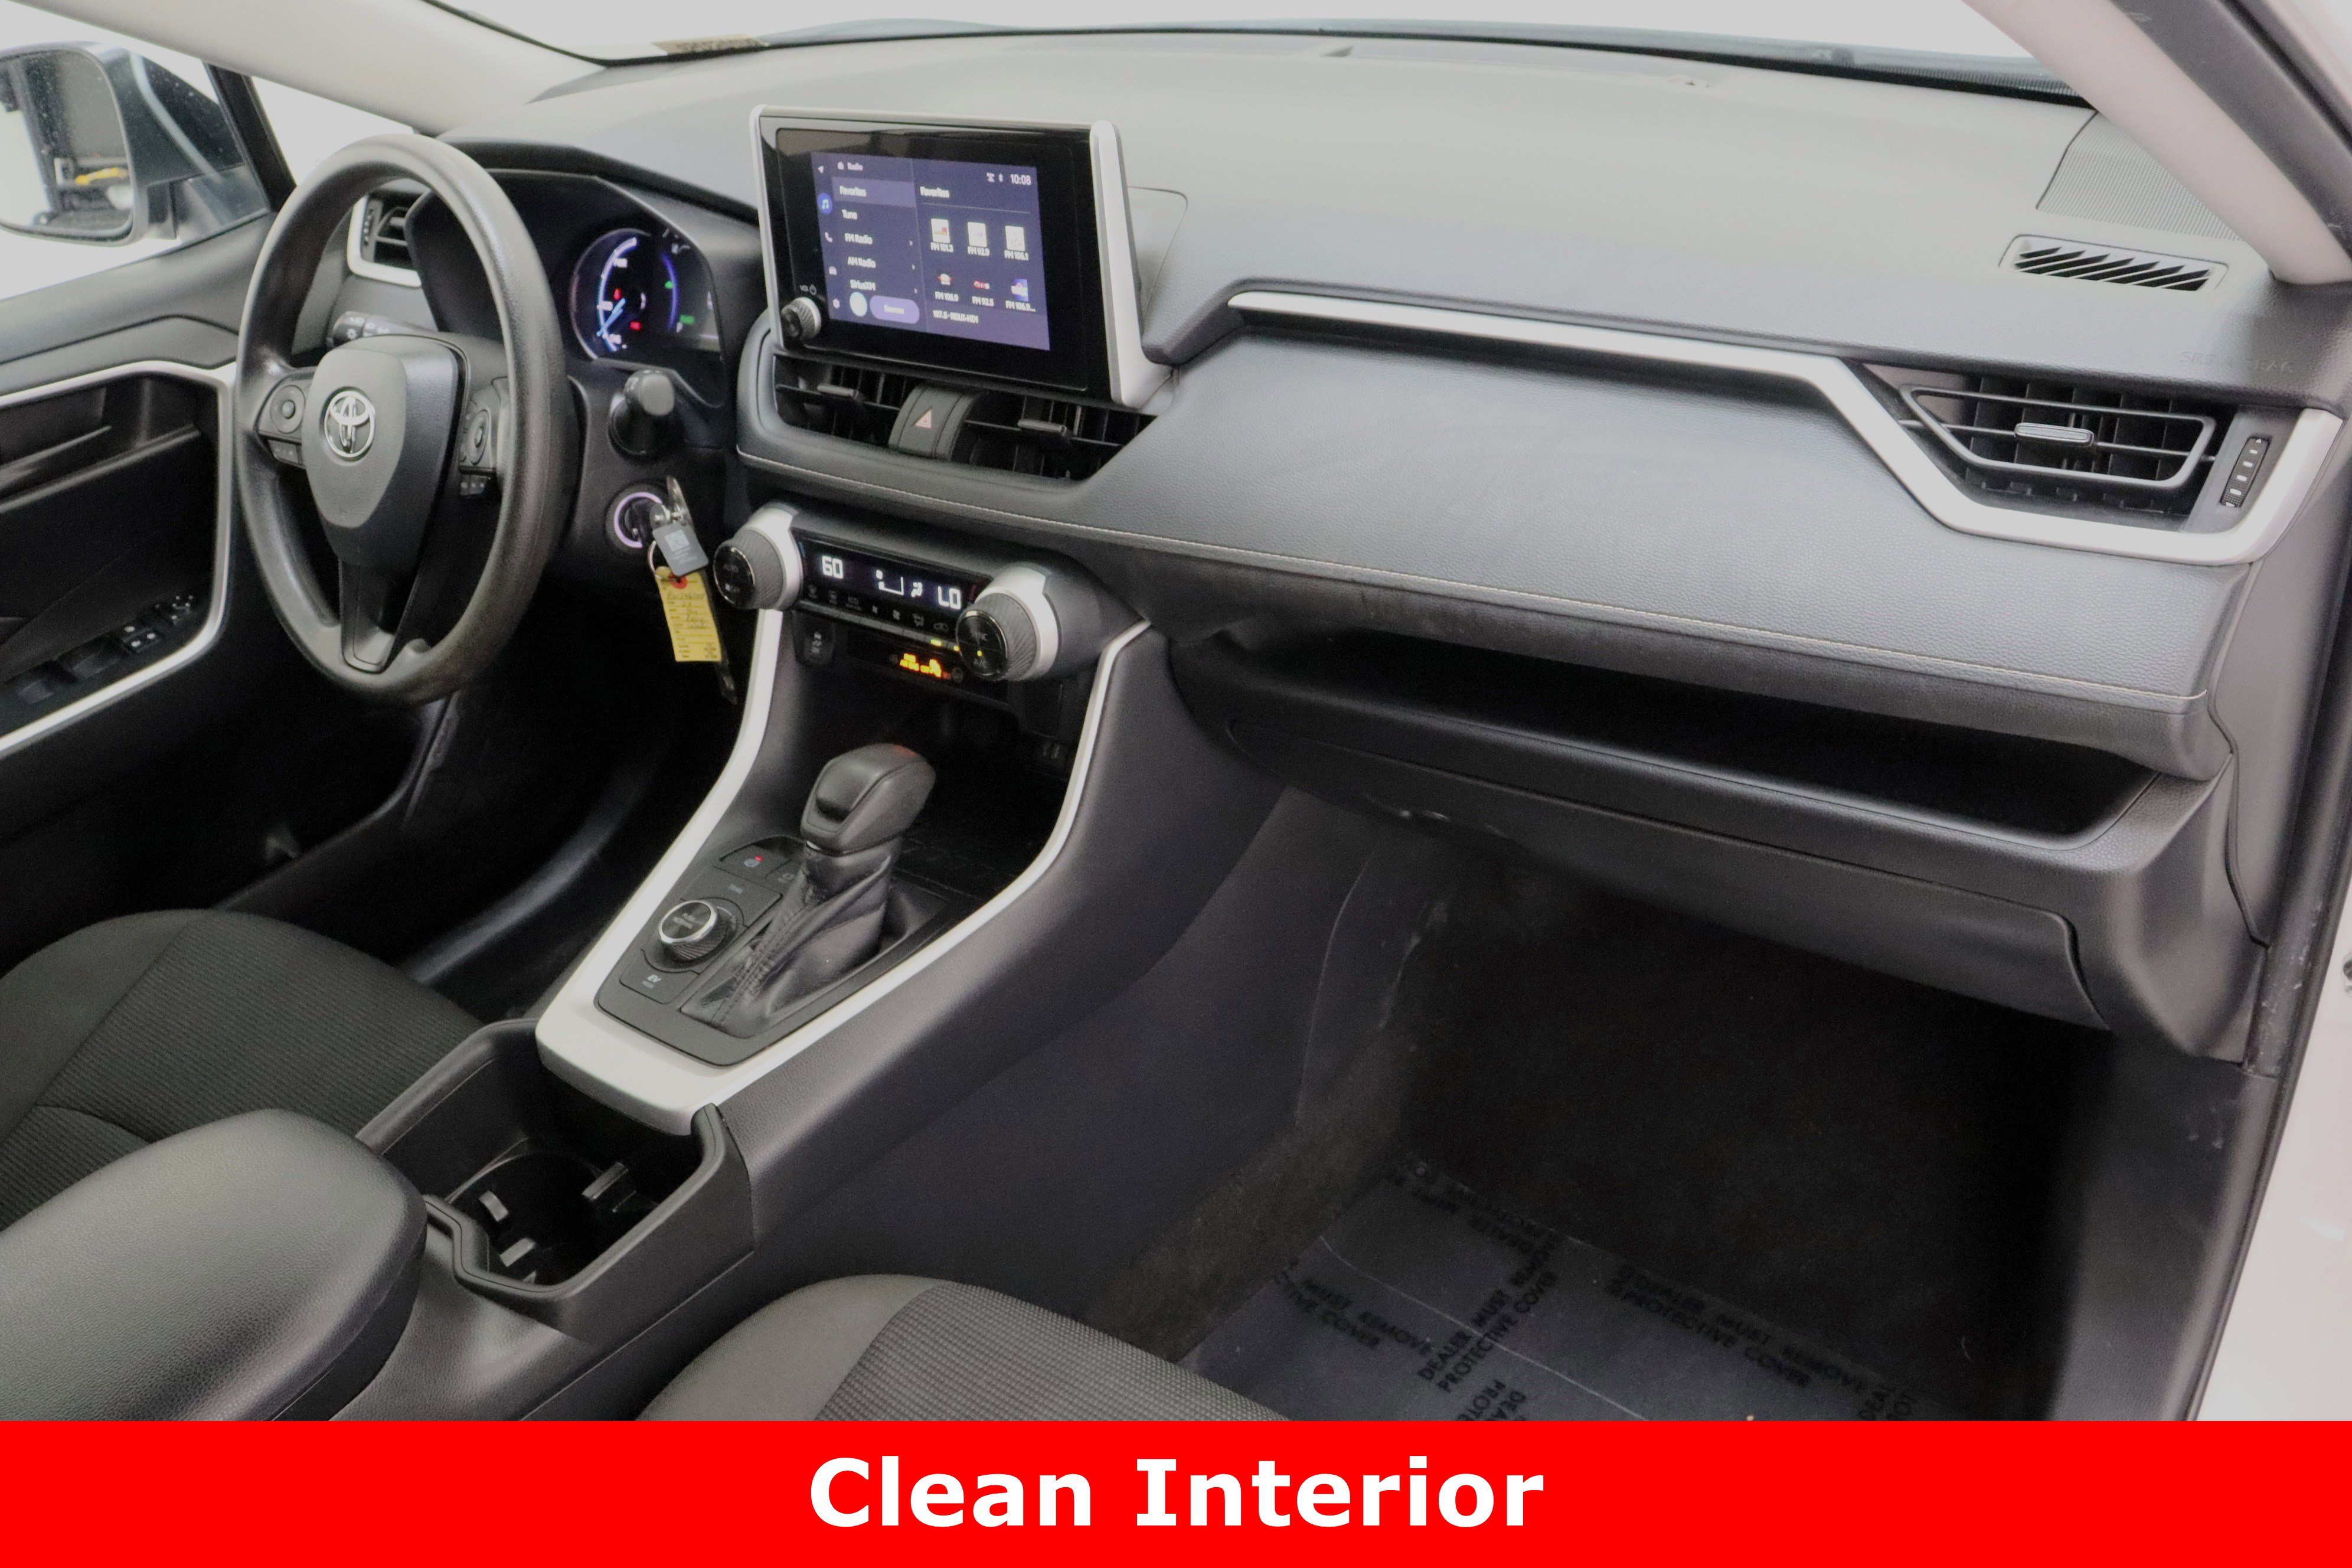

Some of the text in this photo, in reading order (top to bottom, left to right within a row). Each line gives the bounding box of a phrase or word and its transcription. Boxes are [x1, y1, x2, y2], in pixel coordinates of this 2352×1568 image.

[1010, 174, 1032, 186] 10:08
[839, 185, 867, 197] Favorites
[919, 186, 950, 198] Favorites
[841, 208, 858, 220] Tune
[844, 233, 873, 245] FM Radio
[930, 241, 940, 251] FM
[967, 246, 990, 257] FM 92.9
[1004, 250, 1015, 259] FM
[847, 256, 877, 269] AM Radio
[849, 279, 877, 292] SiriusXM
[934, 291, 944, 300] FM
[971, 296, 994, 307] FM 92.5
[1005, 300, 1015, 309] FM
[1416, 1329, 1472, 1381] DEALER
[1470, 1289, 1510, 1328] MUST
[1436, 1313, 1518, 1393] PROTECTIVE
[1512, 1269, 1559, 1314] COVER
